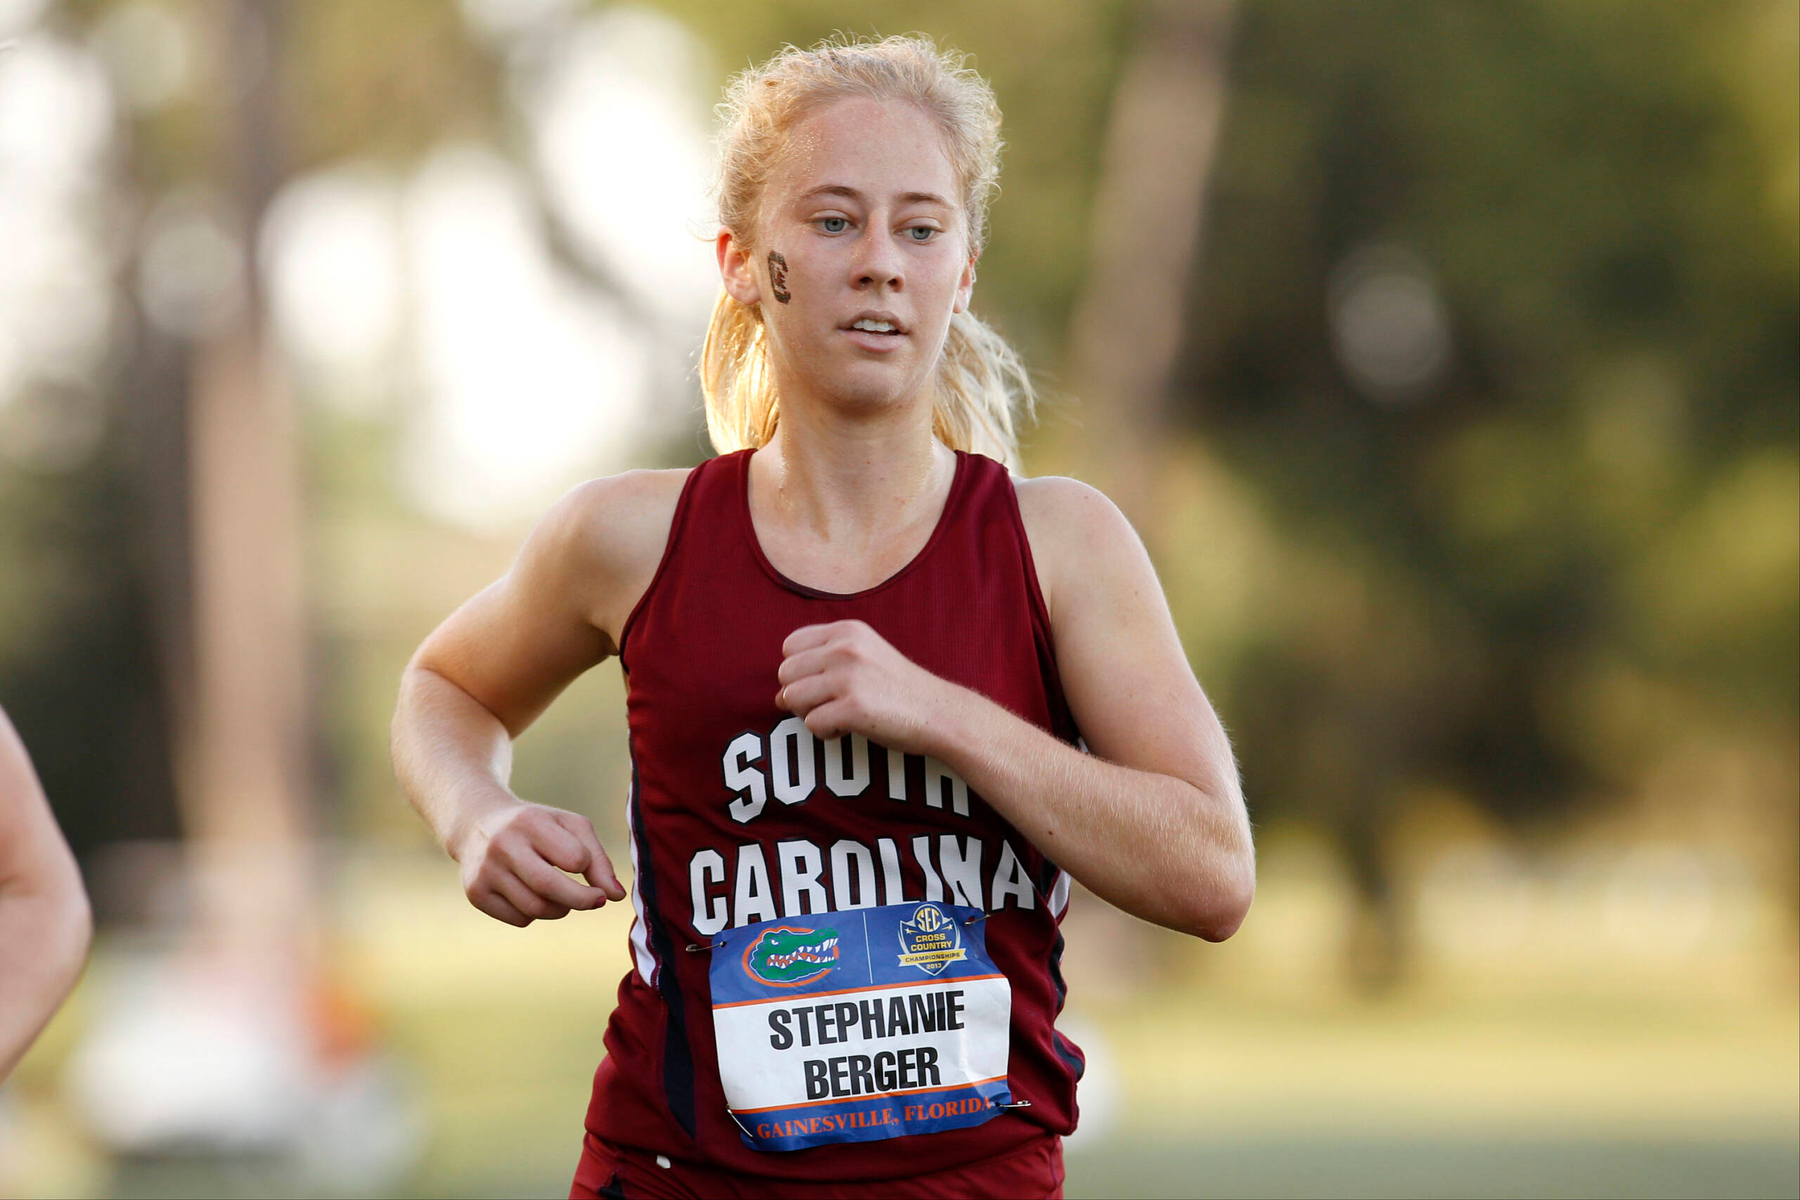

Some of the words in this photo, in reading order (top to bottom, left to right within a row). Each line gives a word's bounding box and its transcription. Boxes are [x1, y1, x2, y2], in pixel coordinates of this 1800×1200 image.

[689, 834, 1035, 935] CAROLINA
[916, 908, 941, 932] SEC
[910, 941, 953, 951] COUNTRY
[915, 933, 946, 943] CROSS
[905, 952, 960, 963] CHAMPIONSHIPS
[768, 990, 965, 1050] STEPHANIE
[803, 1046, 941, 1100] BERGER
[757, 1108, 899, 1139] GAINESVILLE,
[904, 1096, 992, 1121] FLORIDA
